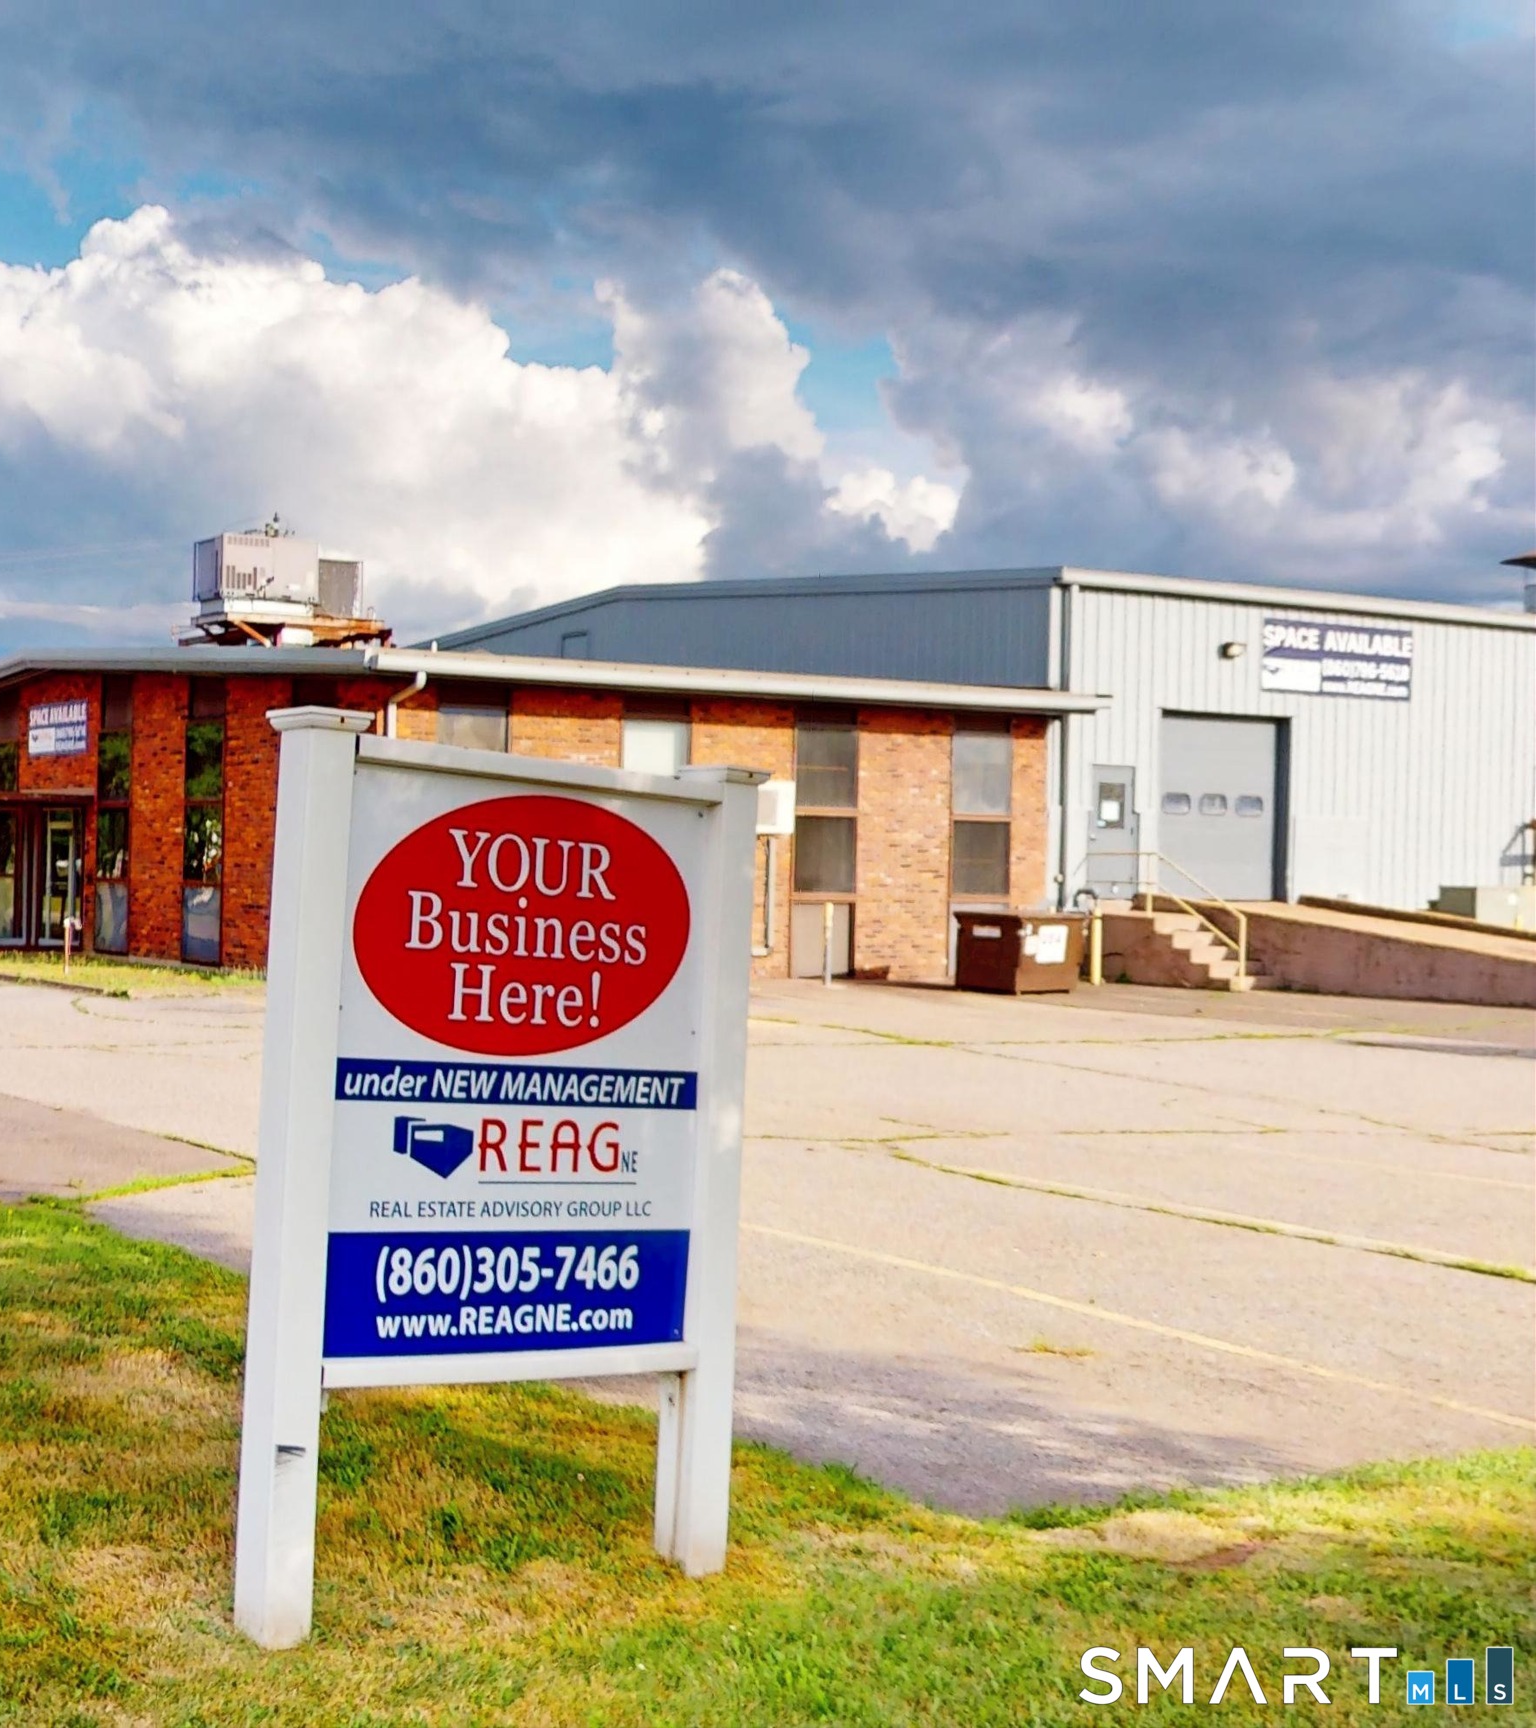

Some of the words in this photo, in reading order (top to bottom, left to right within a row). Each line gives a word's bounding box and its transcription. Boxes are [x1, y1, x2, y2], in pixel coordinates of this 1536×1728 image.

[1264, 625, 1320, 649] SPACE
[1323, 630, 1412, 657] AVAILABLE
[449, 828, 616, 900] YOUR
[404, 889, 648, 965] Business
[447, 962, 602, 1028] Here!
[343, 1065, 426, 1098] under
[431, 1069, 498, 1101] NEW
[499, 1071, 685, 1105] MANAGEMENT
[369, 1200, 412, 1218] REAL
[417, 1200, 476, 1218] ESTATE
[480, 1201, 562, 1217] ADVISORY
[567, 1200, 622, 1217] GROUP
[625, 1200, 652, 1217] LLC
[375, 1245, 640, 1303] (860)305-7466
[376, 1304, 634, 1339] www.REAGNE.com
